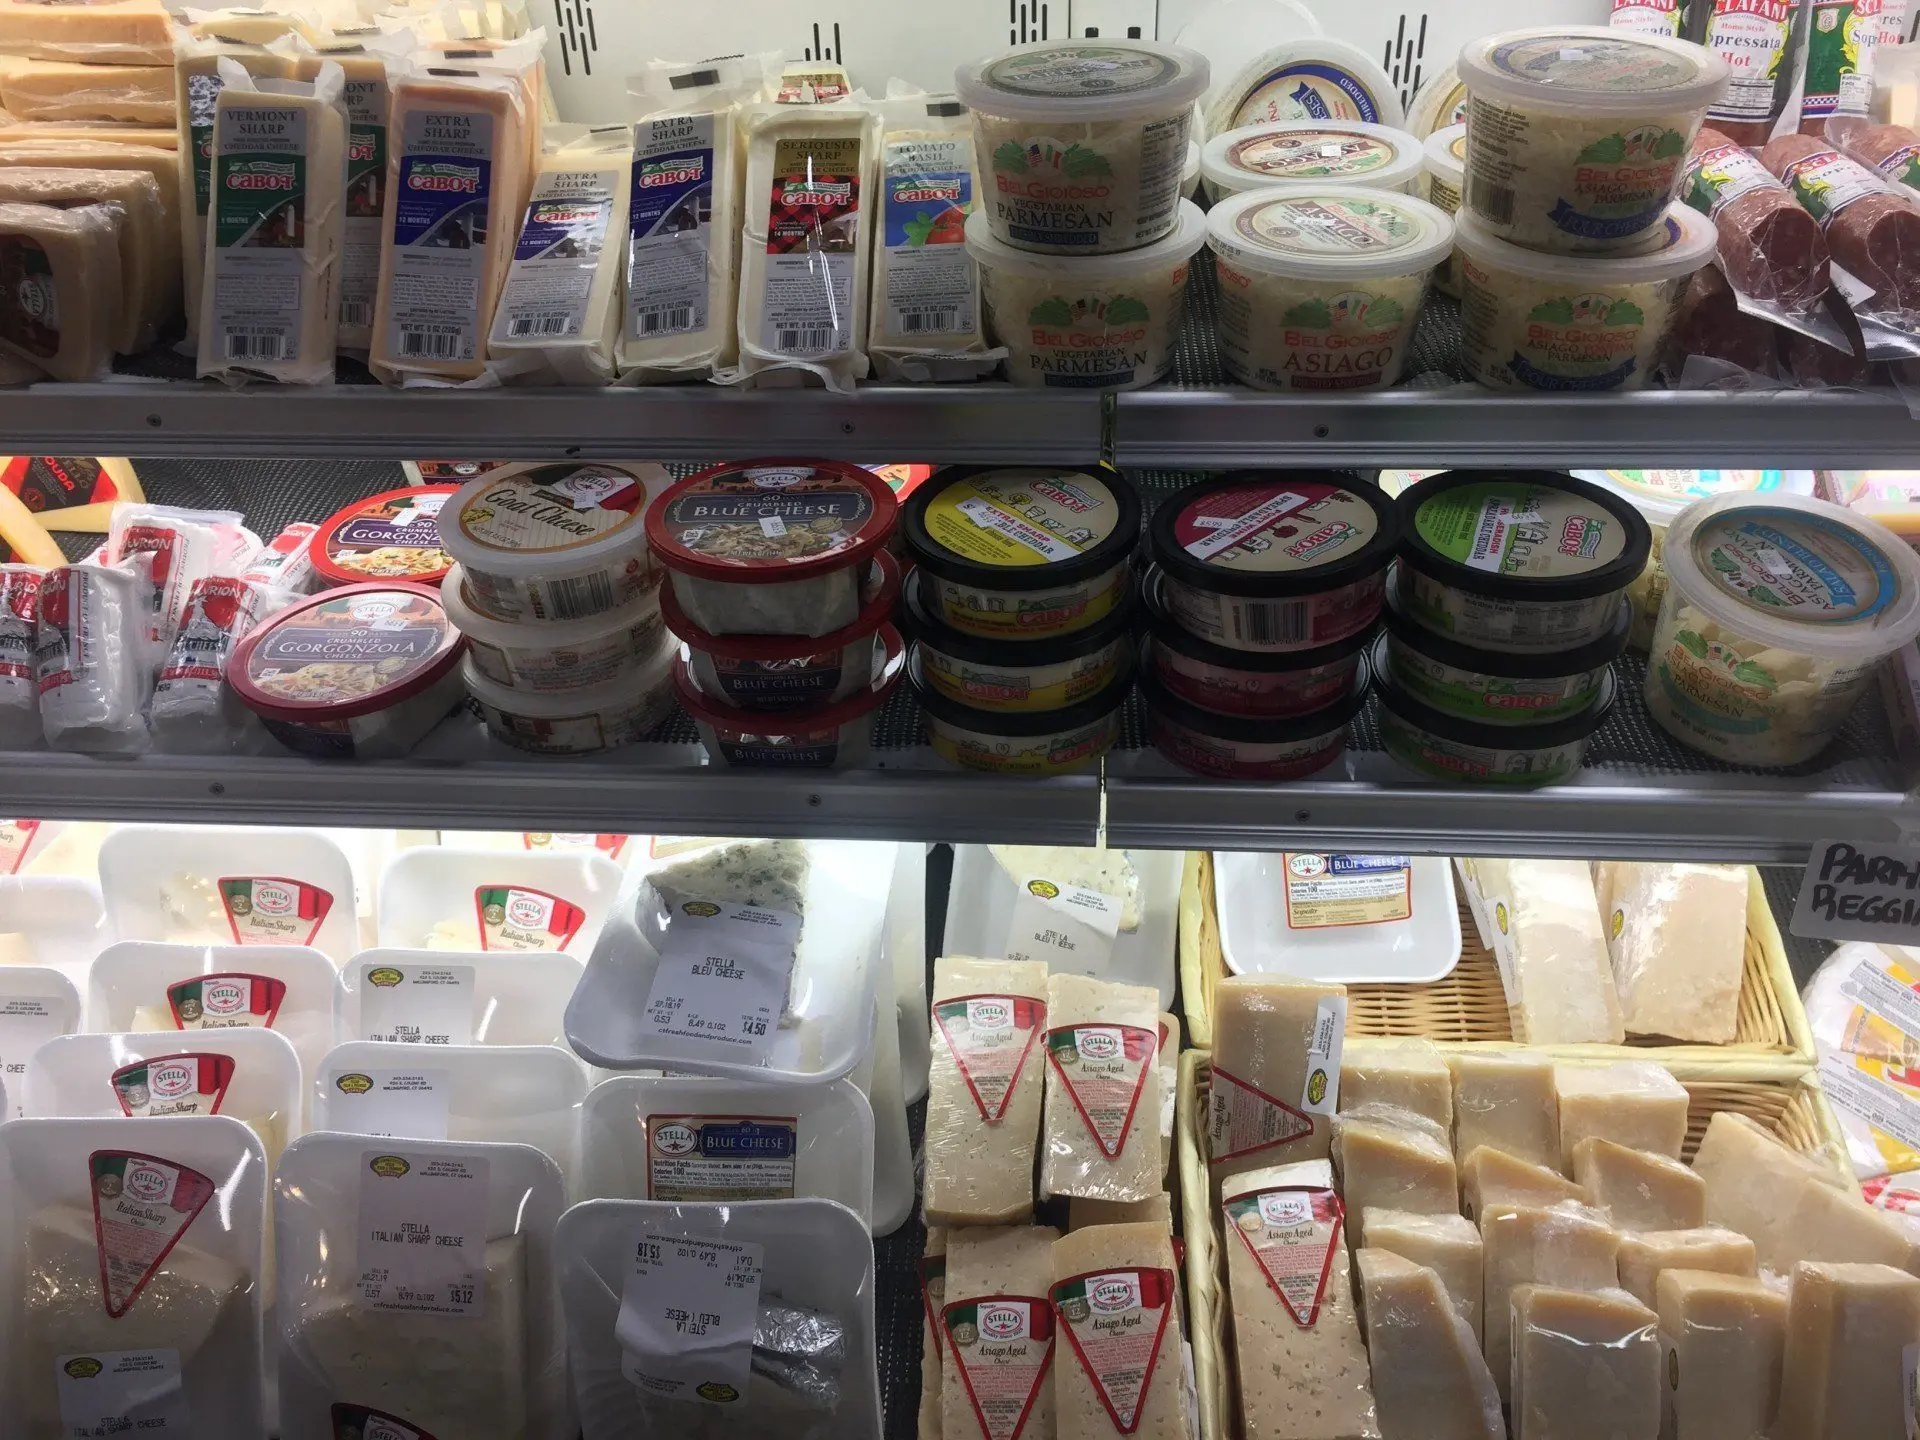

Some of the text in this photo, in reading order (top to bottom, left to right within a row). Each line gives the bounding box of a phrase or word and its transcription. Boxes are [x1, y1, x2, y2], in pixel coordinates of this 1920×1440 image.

[1721, 22, 1766, 32] Home Style
[1339, 76, 1375, 124] SHREDDED
[227, 110, 298, 122] VERMONT
[425, 115, 471, 127] EXTRA
[239, 123, 285, 135] SHARP
[652, 115, 694, 131] EXTRA
[424, 127, 471, 139] SHARP
[652, 126, 694, 142] SHARP
[267, 142, 300, 151] CHEESE
[637, 139, 707, 156] CHEDDAR CHEESE
[782, 140, 858, 150] SERIOUSLY
[899, 142, 956, 153] TOMATO
[556, 173, 598, 181] EXTRA
[554, 181, 597, 189] SHARP
[1013, 198, 1086, 212] VEGETARIAN
[996, 202, 1115, 228] PARMESAN
[1527, 339, 1579, 351] ASIAGO
[1053, 347, 1125, 359] VEGETARIAN
[1029, 350, 1148, 374] PARMESAN
[1283, 346, 1394, 375] ASIAGO
[577, 474, 611, 490] STELLA
[756, 475, 798, 483] STELLA
[484, 488, 534, 515] Goat
[530, 501, 597, 537] Cheese
[693, 504, 841, 517] BLUE CHEESE
[1236, 494, 1293, 529] SPREADABLE
[984, 505, 1018, 530] EXTRA
[1017, 523, 1052, 543] SHARP
[1230, 508, 1282, 542] PORT WINE
[352, 529, 442, 542] GORGONZ
[1012, 527, 1055, 555] CHEDDAR
[1199, 523, 1239, 547] CHEDDAR
[355, 604, 396, 616] STELLA
[351, 629, 367, 637] 90
[279, 641, 415, 654] GORGONZOLA
[732, 676, 825, 690] BLUE CHEESE
[1674, 674, 1745, 719] PARMESAN
[734, 749, 821, 761] BLUE CHEESE
[1291, 857, 1396, 869] STELLA BLUE CHEESE
[1307, 885, 1318, 893] 100
[260, 890, 292, 902] STELLA
[514, 901, 543, 916] STELLA
[1292, 907, 1318, 917] Saputo
[250, 916, 297, 933] Italian Sharp
[500, 926, 545, 947] Italian Sharp
[1034, 932, 1052, 943] BLEU
[706, 956, 735, 968] STELLA
[691, 965, 745, 980] BLEU CHEESE
[210, 989, 241, 1001] STELLA
[975, 1007, 1004, 1016] STELLA
[394, 1026, 420, 1035] STELLA
[654, 1014, 767, 1037] 0.53 8.49 0.102 $4.50
[400, 1035, 450, 1045] SHARP CHEESE
[657, 1026, 753, 1045] ctfreshfoodandproduce.com
[993, 1032, 1013, 1042] Aged
[1084, 1036, 1114, 1047] STELLA
[1080, 1062, 1125, 1074] Asiago Aged
[156, 1070, 187, 1084] STELLA
[149, 1102, 198, 1116] Italian Sharp
[656, 1130, 784, 1149] STELLA BLUE CHEESE
[653, 1160, 692, 1168] Nutrition Facts
[673, 1166, 685, 1175] 100
[134, 1171, 165, 1187] STELLA
[116, 1202, 167, 1225] Italian Sharp
[401, 1223, 430, 1235] STELLA
[1266, 1227, 1314, 1240] Asiago Aged
[371, 1231, 464, 1247] ITALIAN SHARP CHEESE
[646, 1234, 744, 1252] ctfreshfoodandproduce.com
[637, 1242, 753, 1266] 0.61 $5.18
[1097, 1284, 1128, 1296] STELLA
[450, 1290, 474, 1304] $5.12
[1071, 1307, 1081, 1316] 12
[699, 1314, 721, 1326] BLEU
[987, 1313, 1018, 1325] STELLA
[1092, 1314, 1142, 1331] Asiago Aged
[978, 1344, 1027, 1357] Asiago Aged
[100, 1416, 130, 1427] STELLA
[137, 1417, 167, 1428] CHEESE
